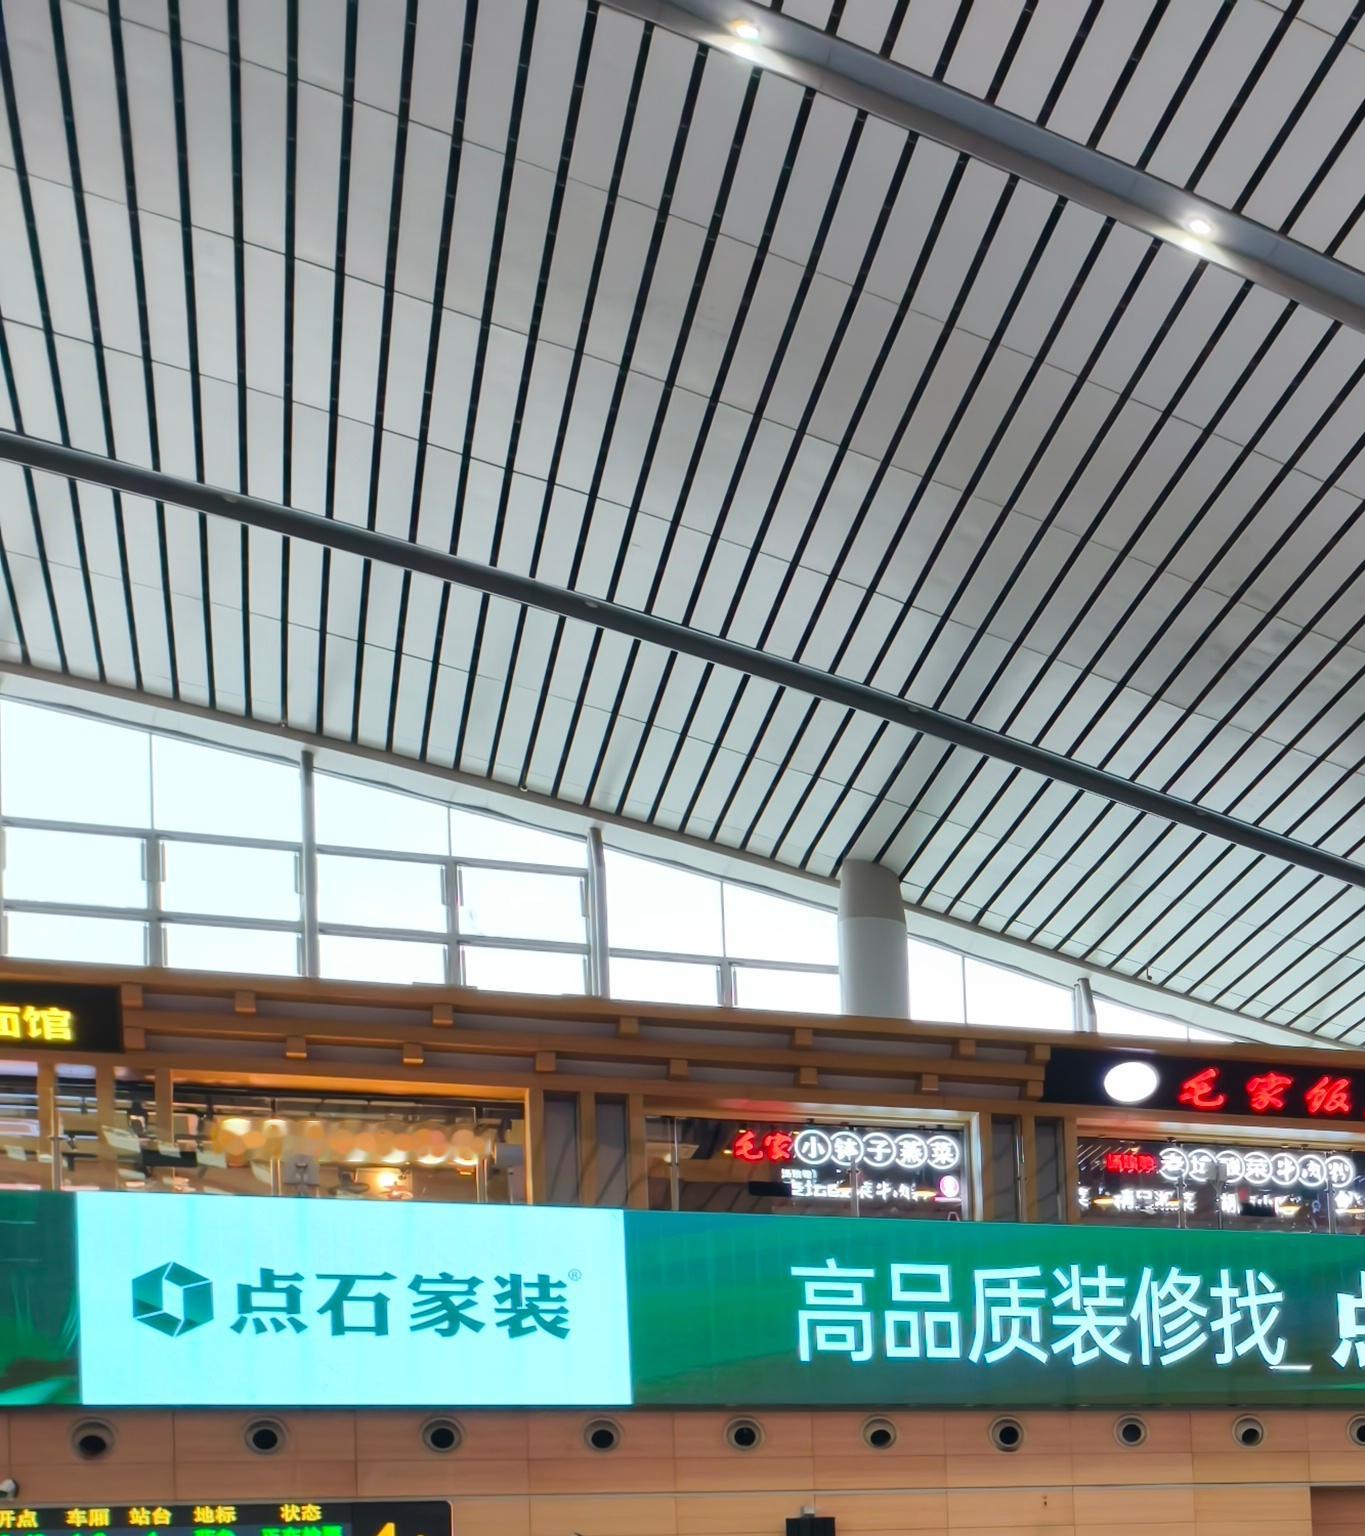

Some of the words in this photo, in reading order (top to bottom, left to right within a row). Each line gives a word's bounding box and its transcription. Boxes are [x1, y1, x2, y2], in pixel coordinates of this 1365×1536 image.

[230, 1267, 571, 1341] 点石家装
[66, 1508, 110, 1527] 车厢
[128, 1507, 172, 1526] 站台
[193, 1505, 237, 1524] 地标
[280, 1503, 322, 1523] 状态
